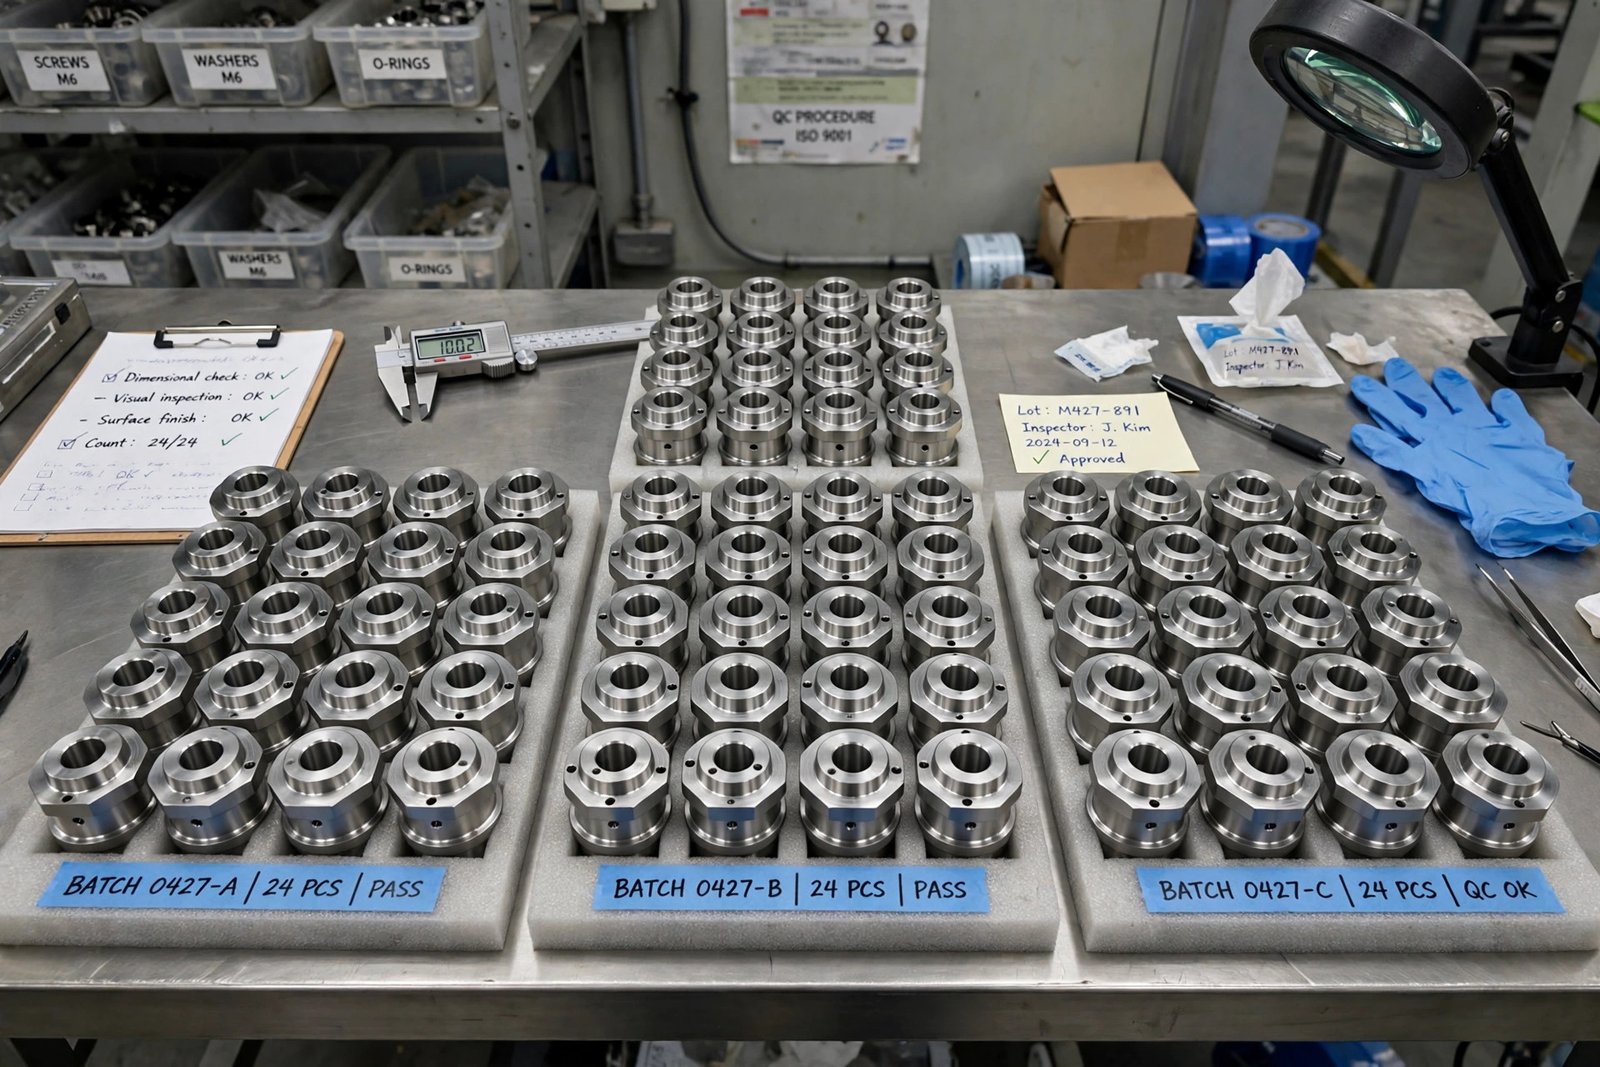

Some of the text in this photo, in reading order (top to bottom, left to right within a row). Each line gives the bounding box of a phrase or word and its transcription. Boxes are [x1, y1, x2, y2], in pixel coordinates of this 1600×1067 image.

[34, 56, 90, 69] SCREWS
[194, 54, 259, 68] WASHERS
[373, 57, 430, 70] O-RINGS
[57, 73, 78, 85] M6
[222, 72, 242, 84] M6
[772, 110, 876, 124] QC PROCEDURE
[795, 129, 852, 142] ISO 9001
[227, 253, 282, 265] WASHERS
[249, 266, 267, 277] M6
[401, 263, 453, 275] O-RINGS
[440, 338, 475, 354] 10.02
[124, 371, 200, 383] Dimensional
[254, 371, 274, 380] OK
[114, 391, 155, 403] Visual
[243, 391, 264, 401] OK
[1058, 405, 1140, 416] M427-891
[97, 414, 152, 425] Surface
[231, 412, 252, 423] OK
[1102, 422, 1116, 432] J.
[1123, 422, 1151, 432] Kim
[147, 434, 198, 450] 24/24
[1026, 438, 1117, 448] 2024-09-12
[1059, 452, 1126, 467] Approved
[63, 875, 424, 898] BATCH 0427-A 24 PCS PASS
[614, 878, 967, 900] BATCH 0427-B 24 PCS PASS
[1158, 879, 1538, 901] BATCH 0427-C 24 PCS QC OK
